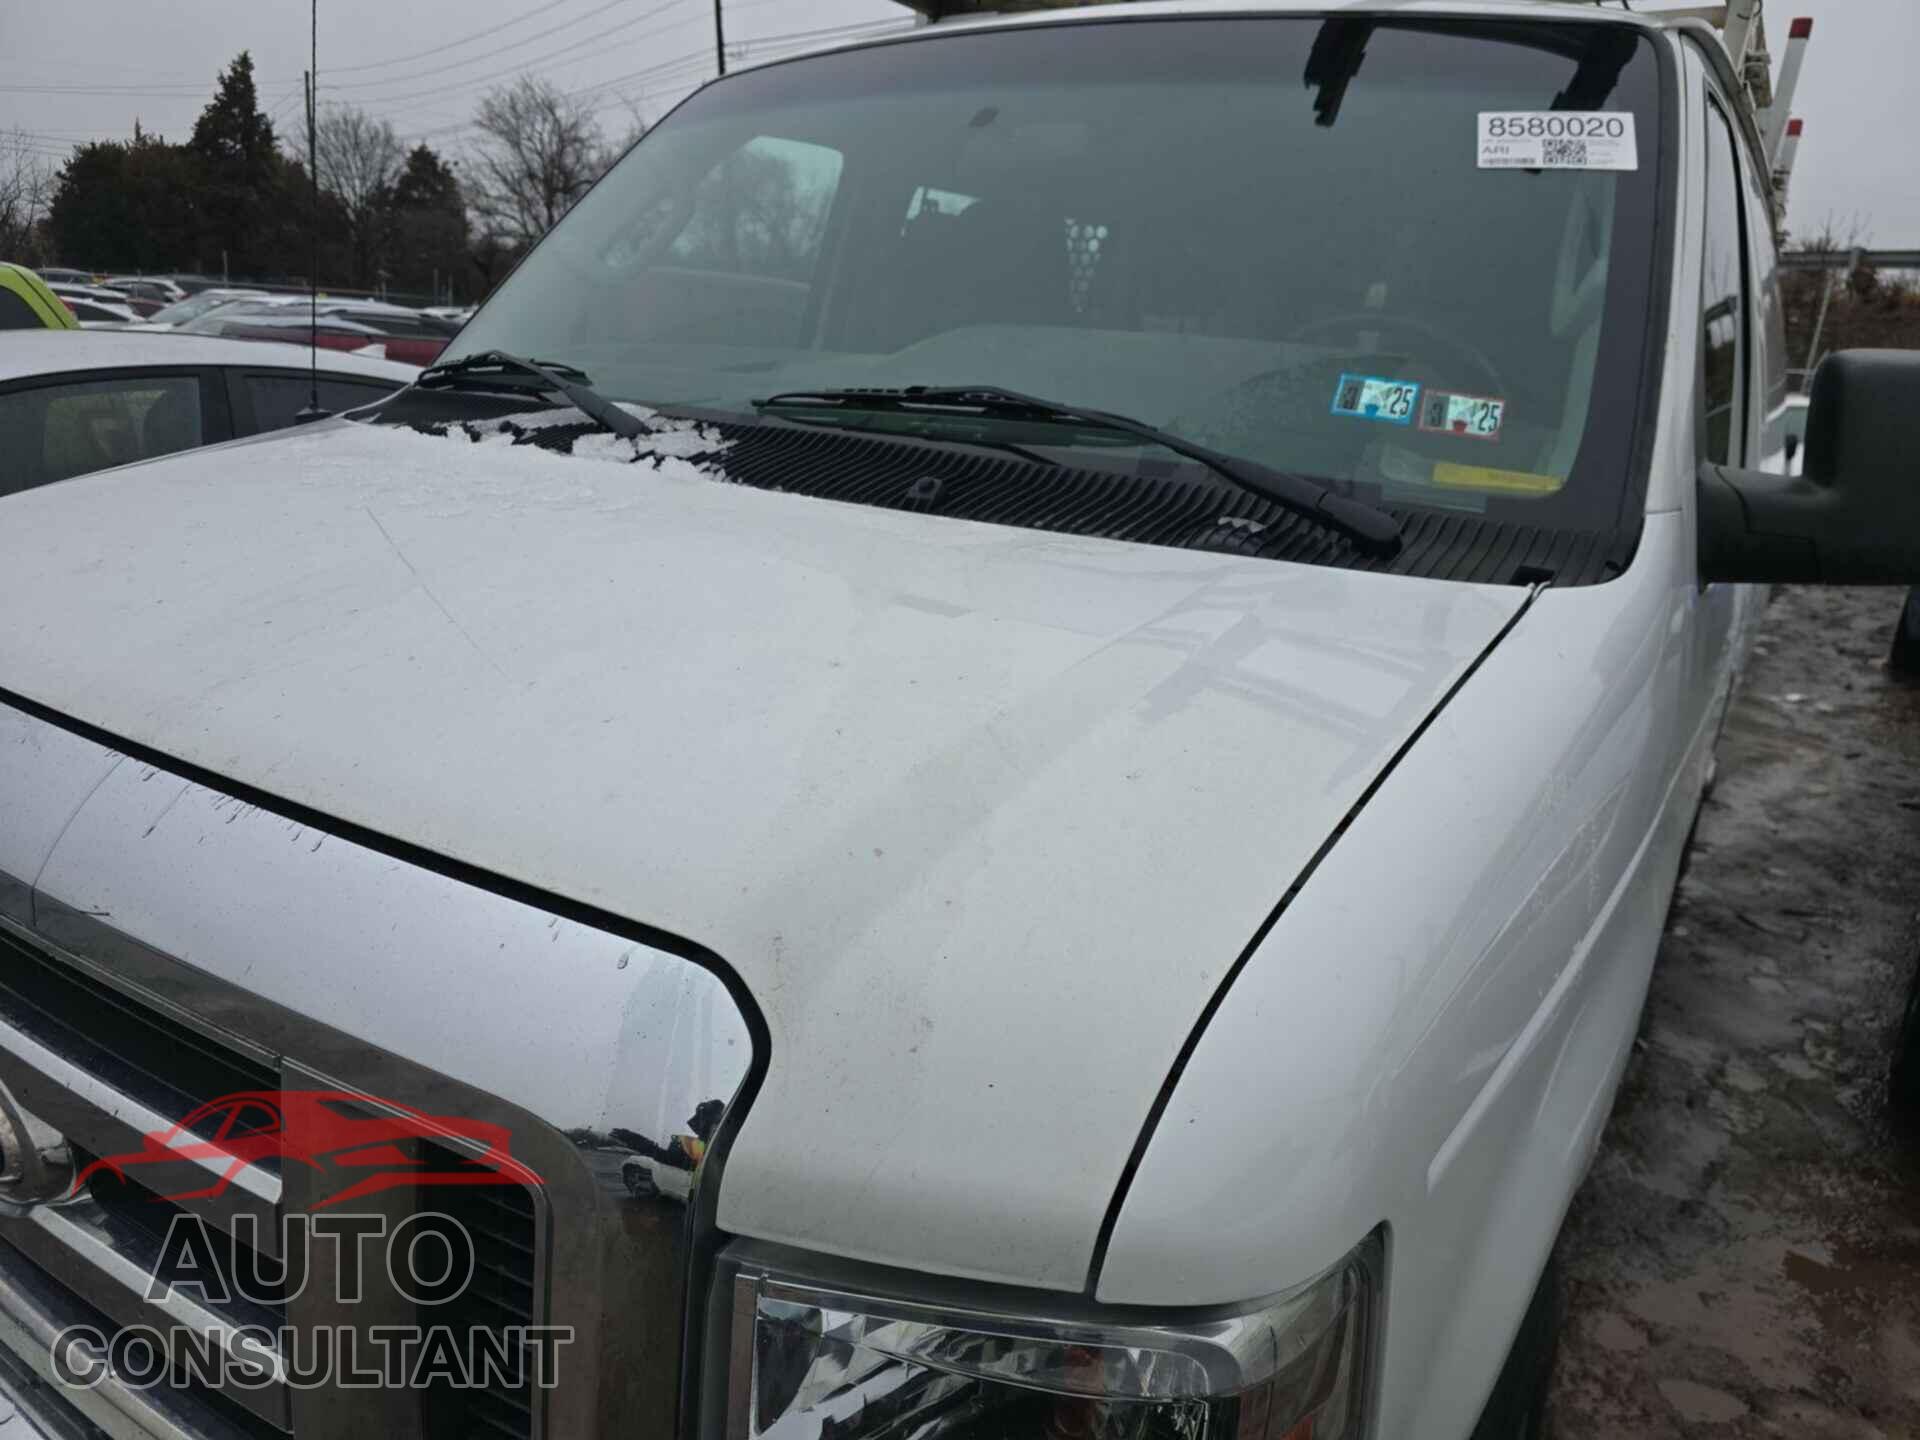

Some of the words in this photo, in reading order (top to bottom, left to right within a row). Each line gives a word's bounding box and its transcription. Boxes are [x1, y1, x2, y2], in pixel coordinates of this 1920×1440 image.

[1488, 117, 1624, 138] 8580020
[1390, 387, 1413, 416] 25
[1478, 402, 1500, 433] 25
